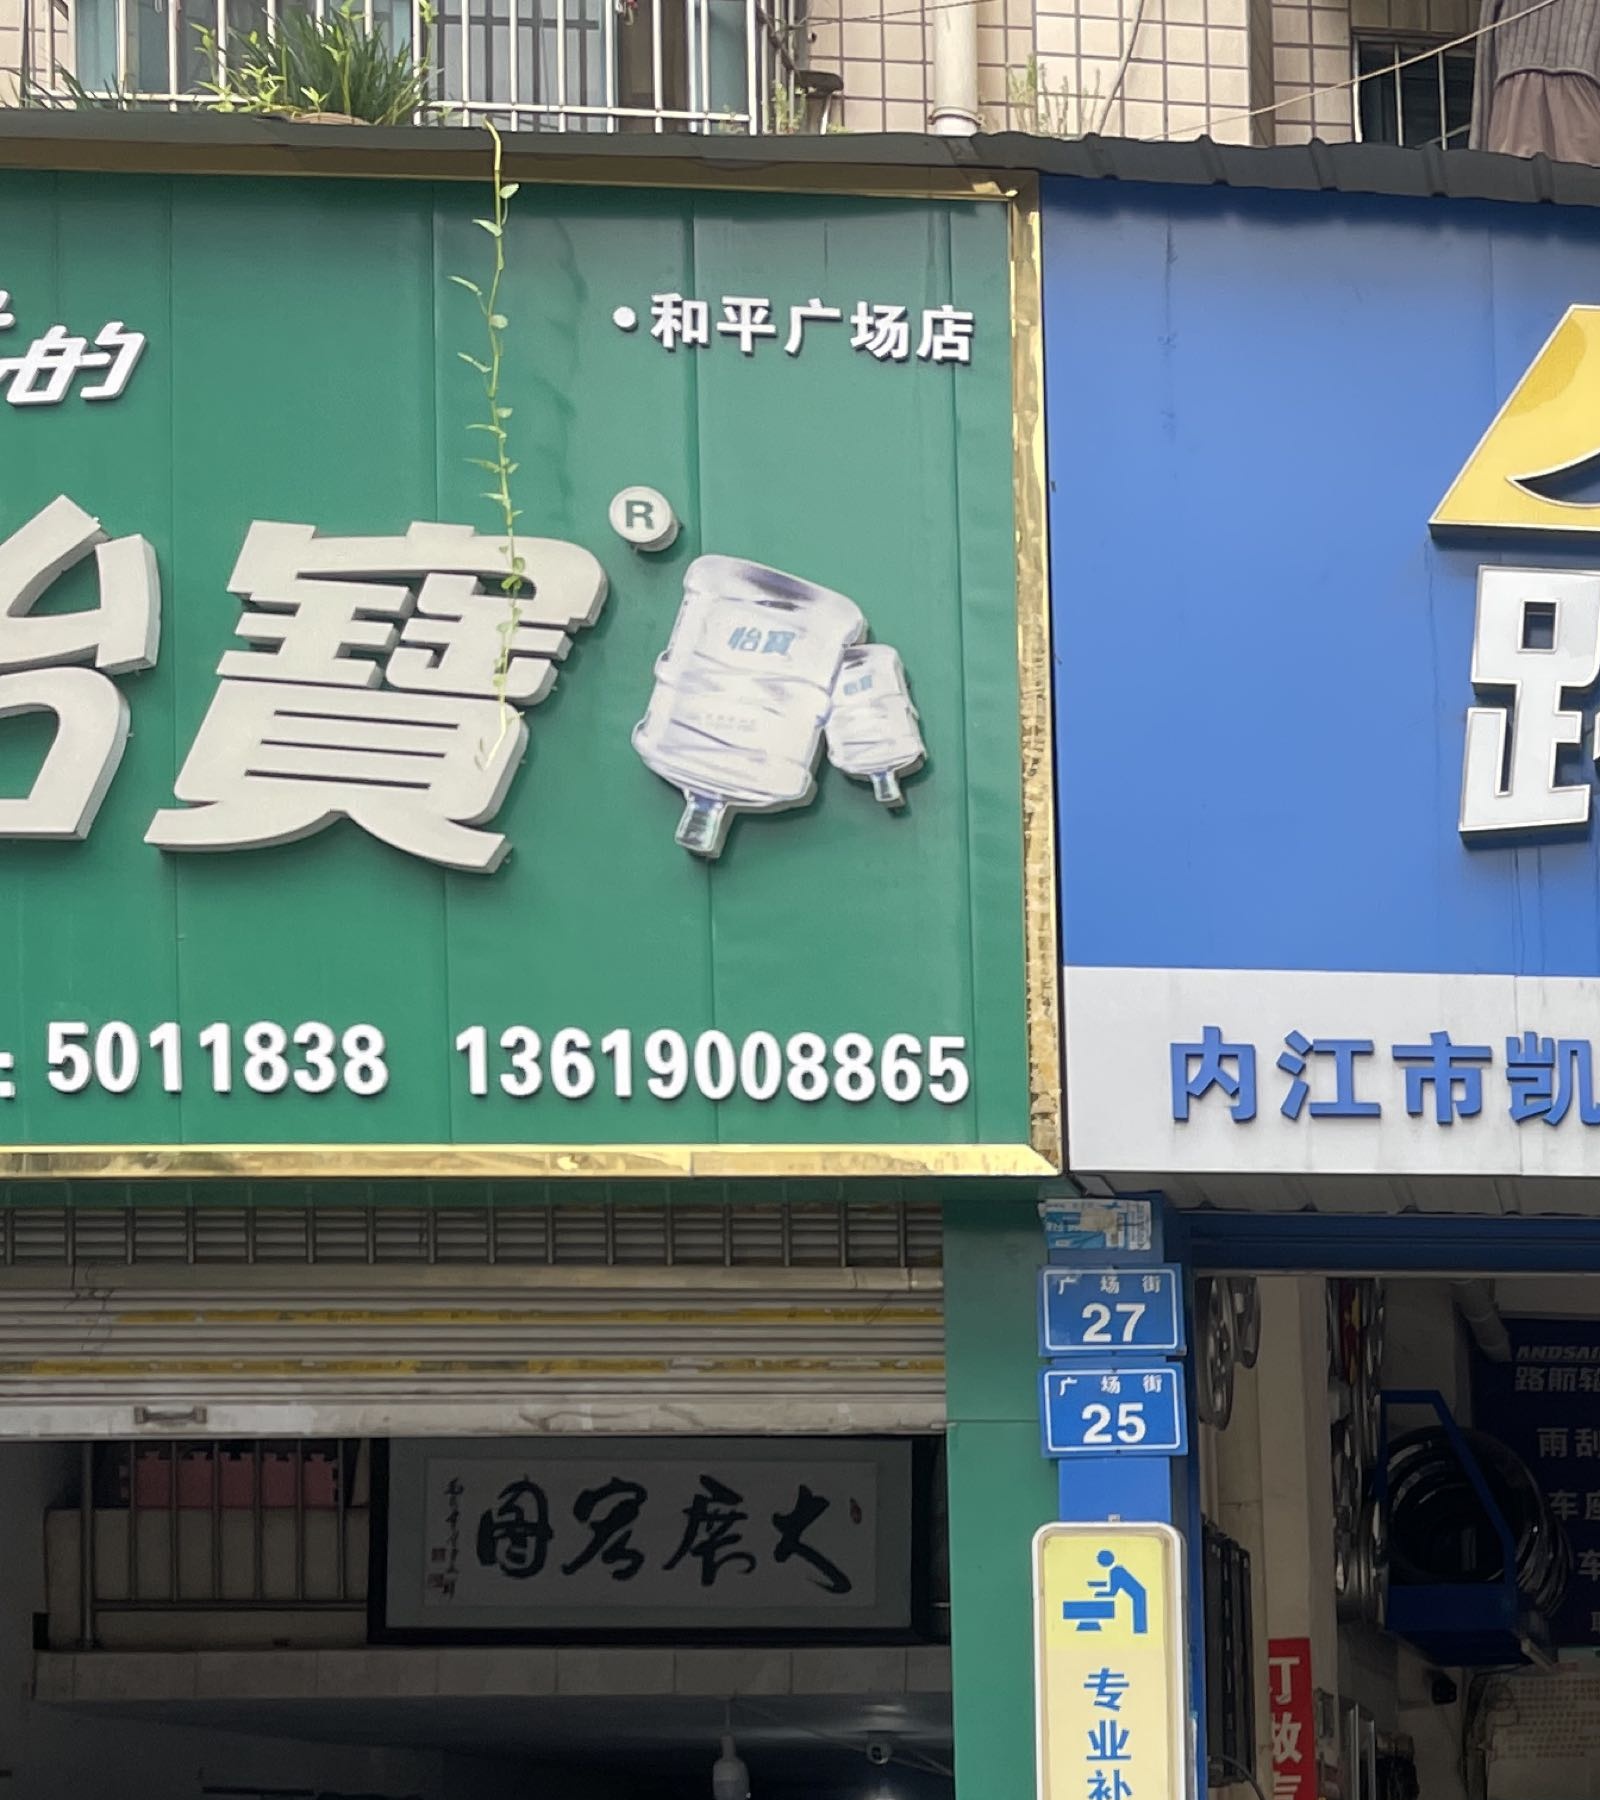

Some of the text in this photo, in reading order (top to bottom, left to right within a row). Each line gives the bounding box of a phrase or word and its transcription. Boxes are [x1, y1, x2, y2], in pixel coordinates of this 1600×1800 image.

[0, 290, 145, 405] 的
[45, 1020, 970, 1104] 5011838 13619008865
[1057, 1274, 1161, 1295] 广场街
[1082, 1303, 1146, 1344] 27
[1058, 1375, 1163, 1396] 广场街
[1082, 1403, 1146, 1445] 25
